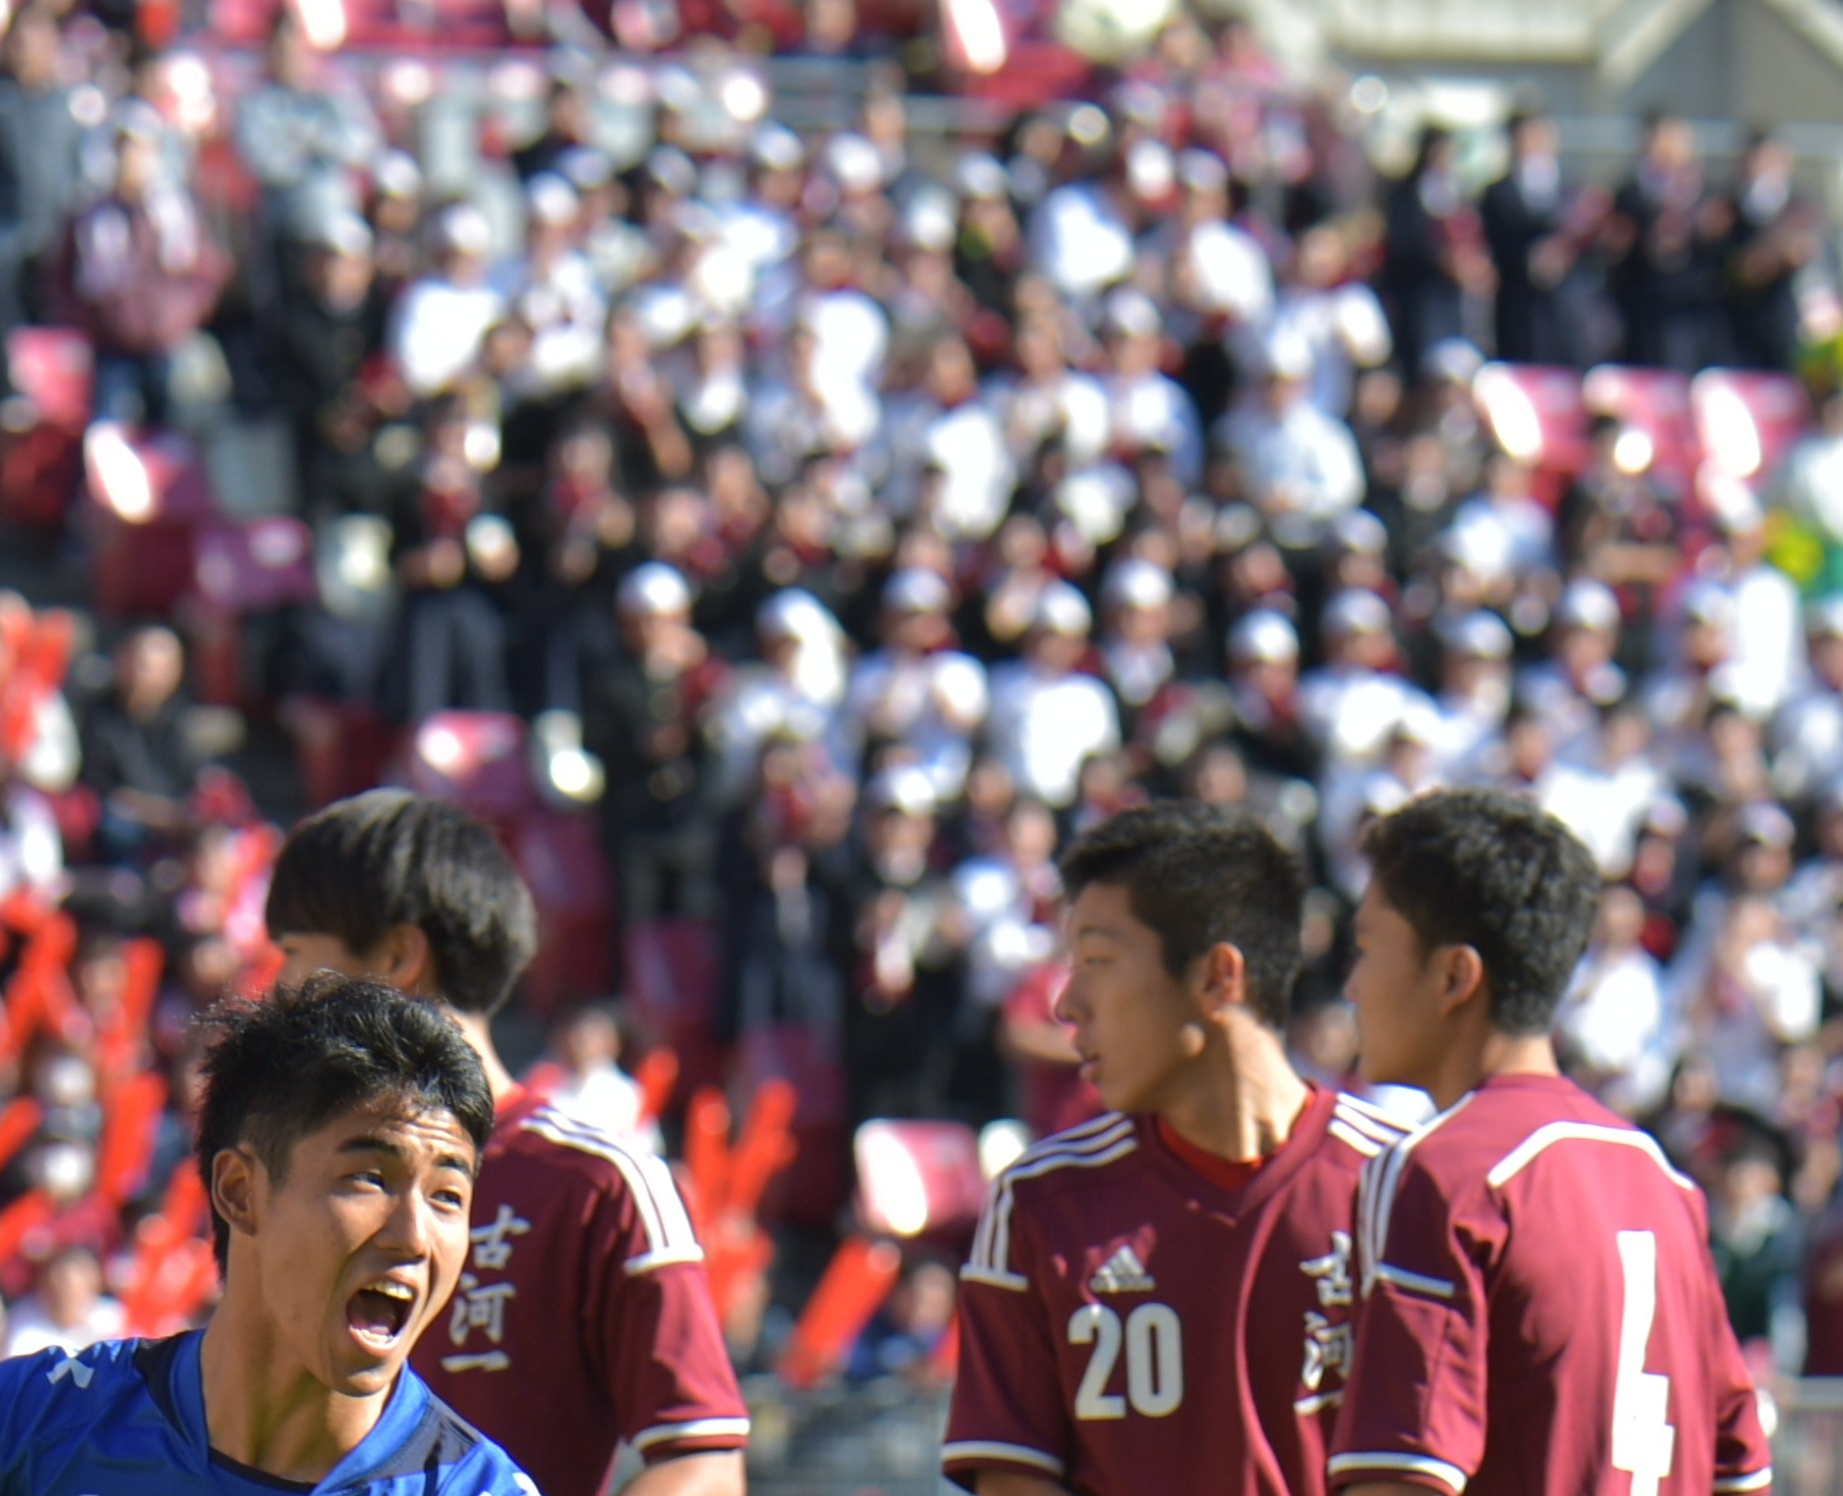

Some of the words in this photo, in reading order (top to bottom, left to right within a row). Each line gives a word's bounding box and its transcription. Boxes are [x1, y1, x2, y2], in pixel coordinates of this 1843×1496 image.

[441, 1205, 531, 1374] 古河一
[1068, 1302, 1183, 1420] 20
